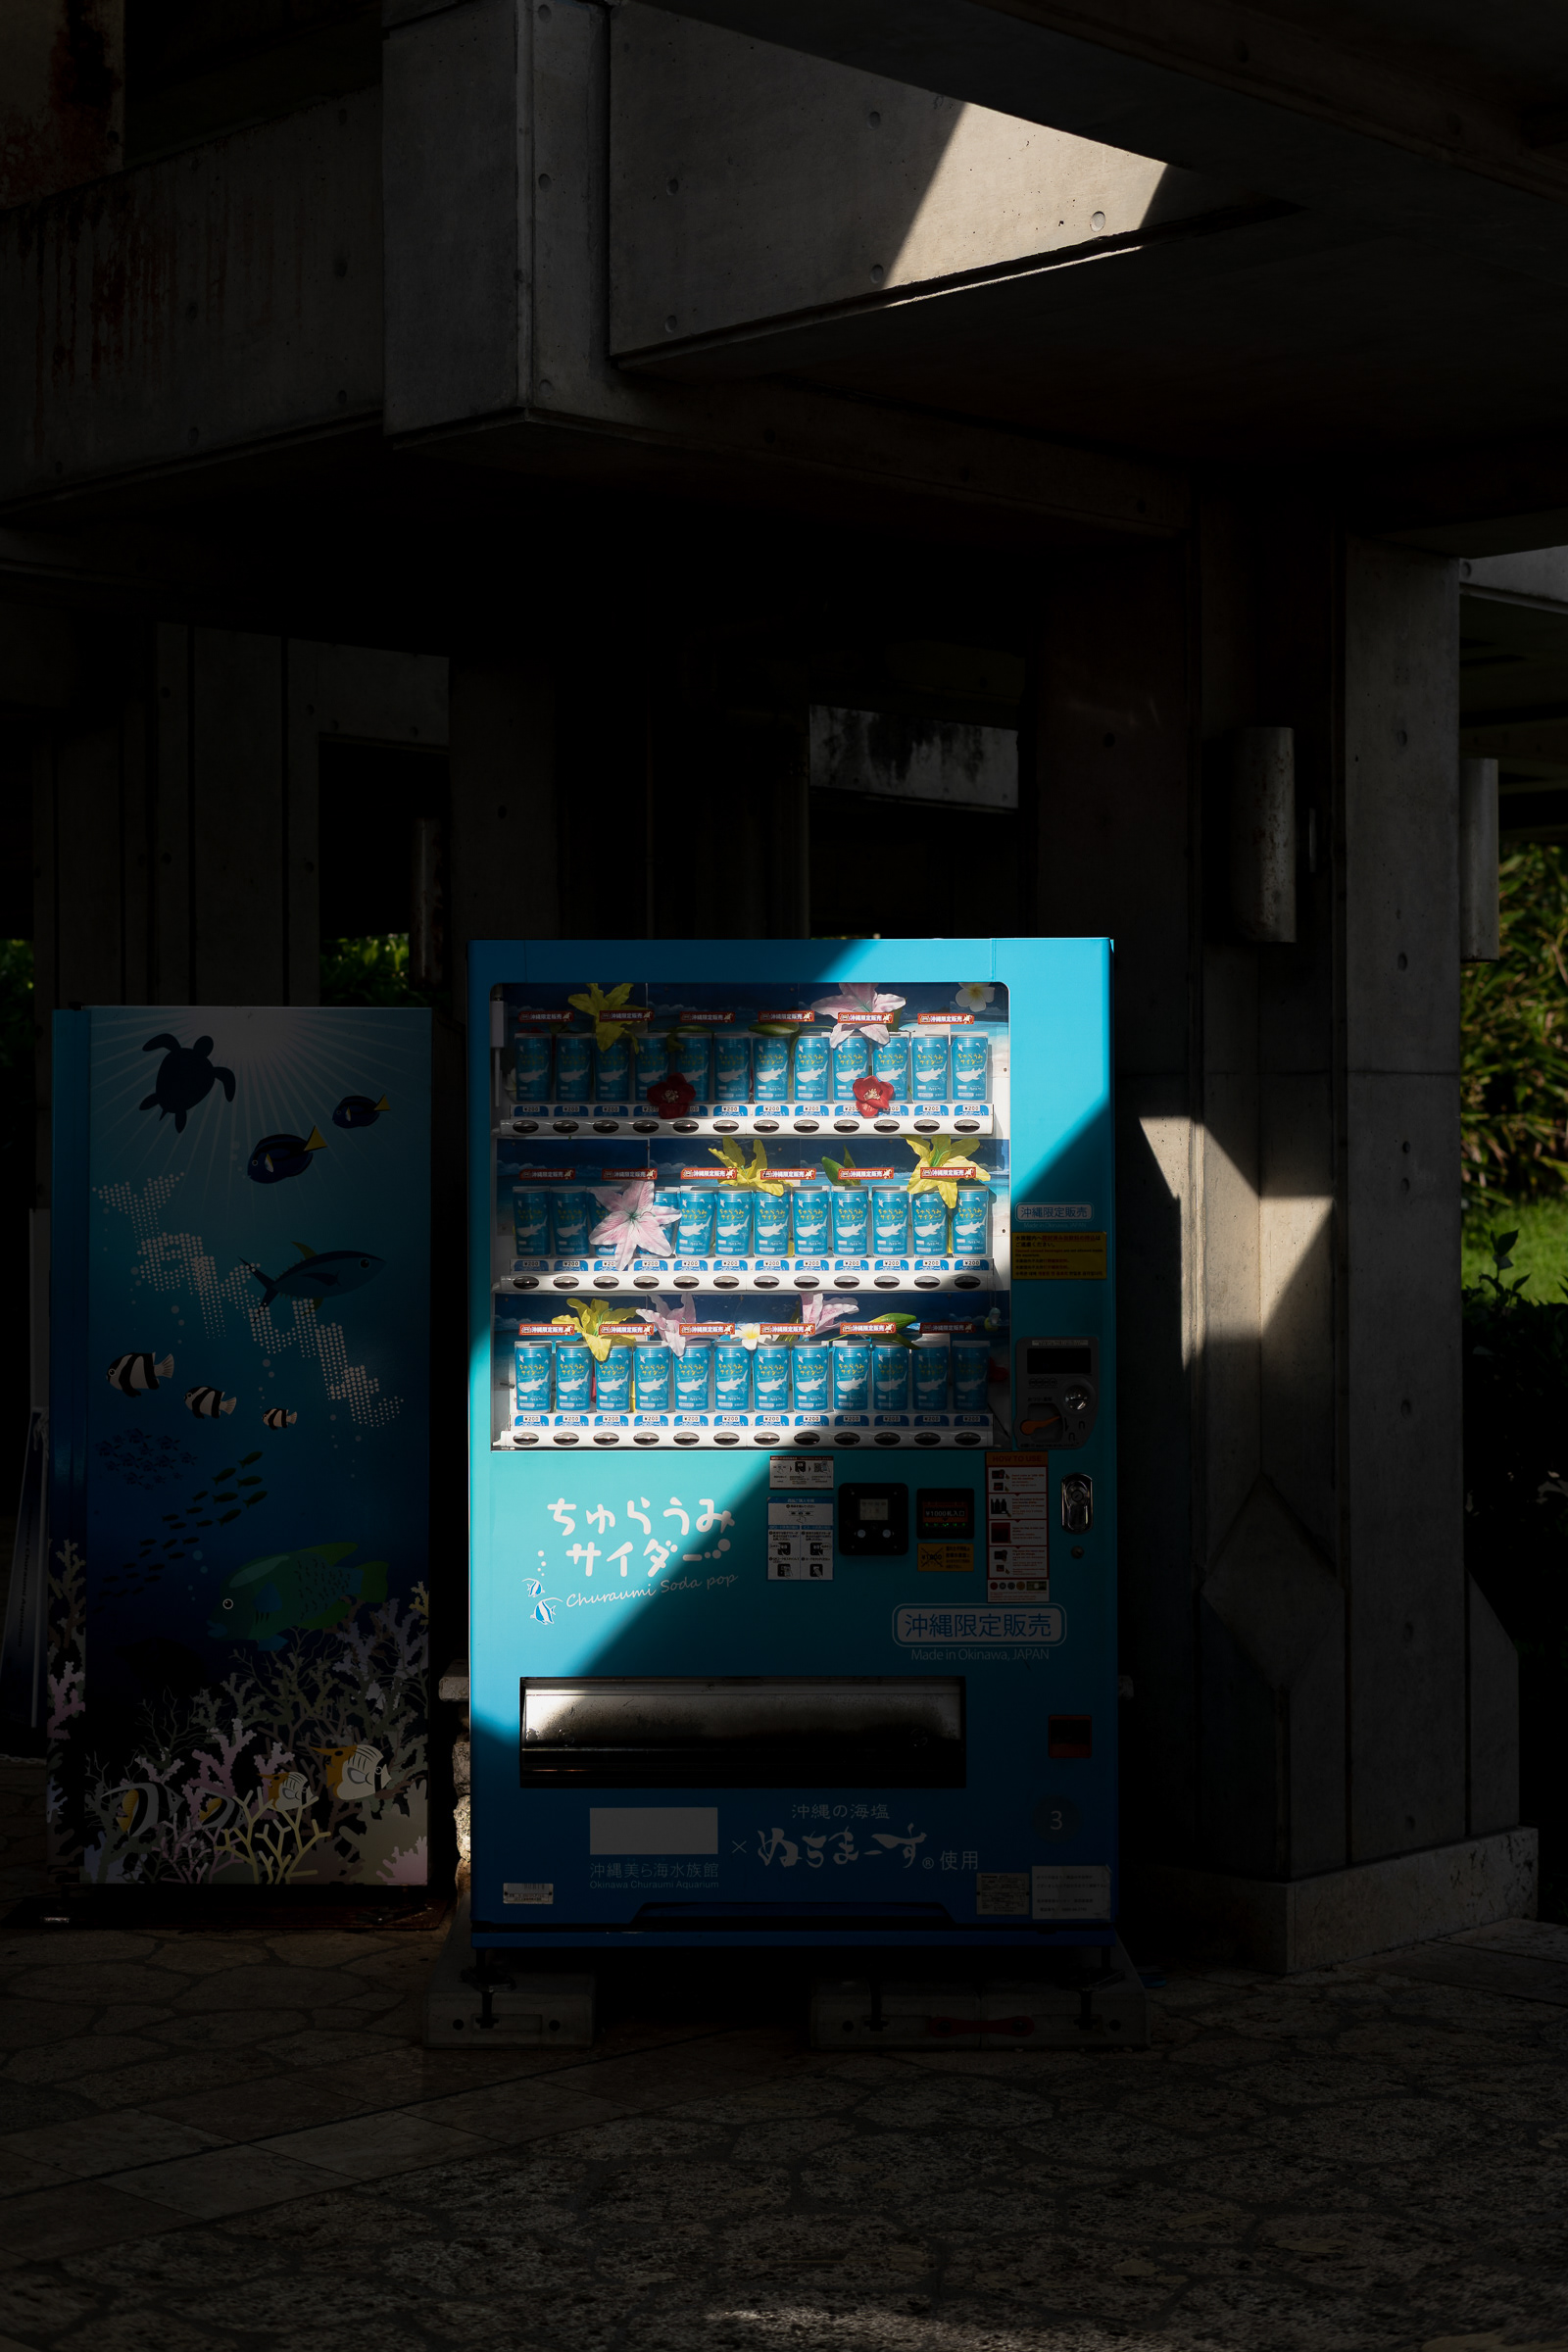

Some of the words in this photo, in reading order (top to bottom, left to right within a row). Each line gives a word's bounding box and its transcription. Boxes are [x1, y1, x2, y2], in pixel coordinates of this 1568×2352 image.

[1020, 1206, 1088, 1218] 沖縄限定販売
[547, 1496, 735, 1536] ちゅらうみ
[565, 1538, 704, 1578] サイダー
[565, 1583, 658, 1608] Churaumi
[660, 1577, 703, 1594] Soda
[706, 1573, 739, 1593] pop
[905, 1613, 1052, 1639] 沖縄限定販売
[911, 1648, 944, 1661] Made
[946, 1648, 956, 1661] in
[957, 1648, 1010, 1663] Okinawa,
[1012, 1648, 1051, 1662] JAPAN
[792, 1803, 891, 1820] 沖縄の海塩
[1050, 1810, 1063, 1830] 3
[590, 1862, 719, 1879] 沖縄美ら海水族館
[940, 1850, 979, 1871] 使用
[590, 1880, 628, 1889] Okinawa
[630, 1880, 674, 1889] Churaumi
[676, 1880, 719, 1890] Aquarium
